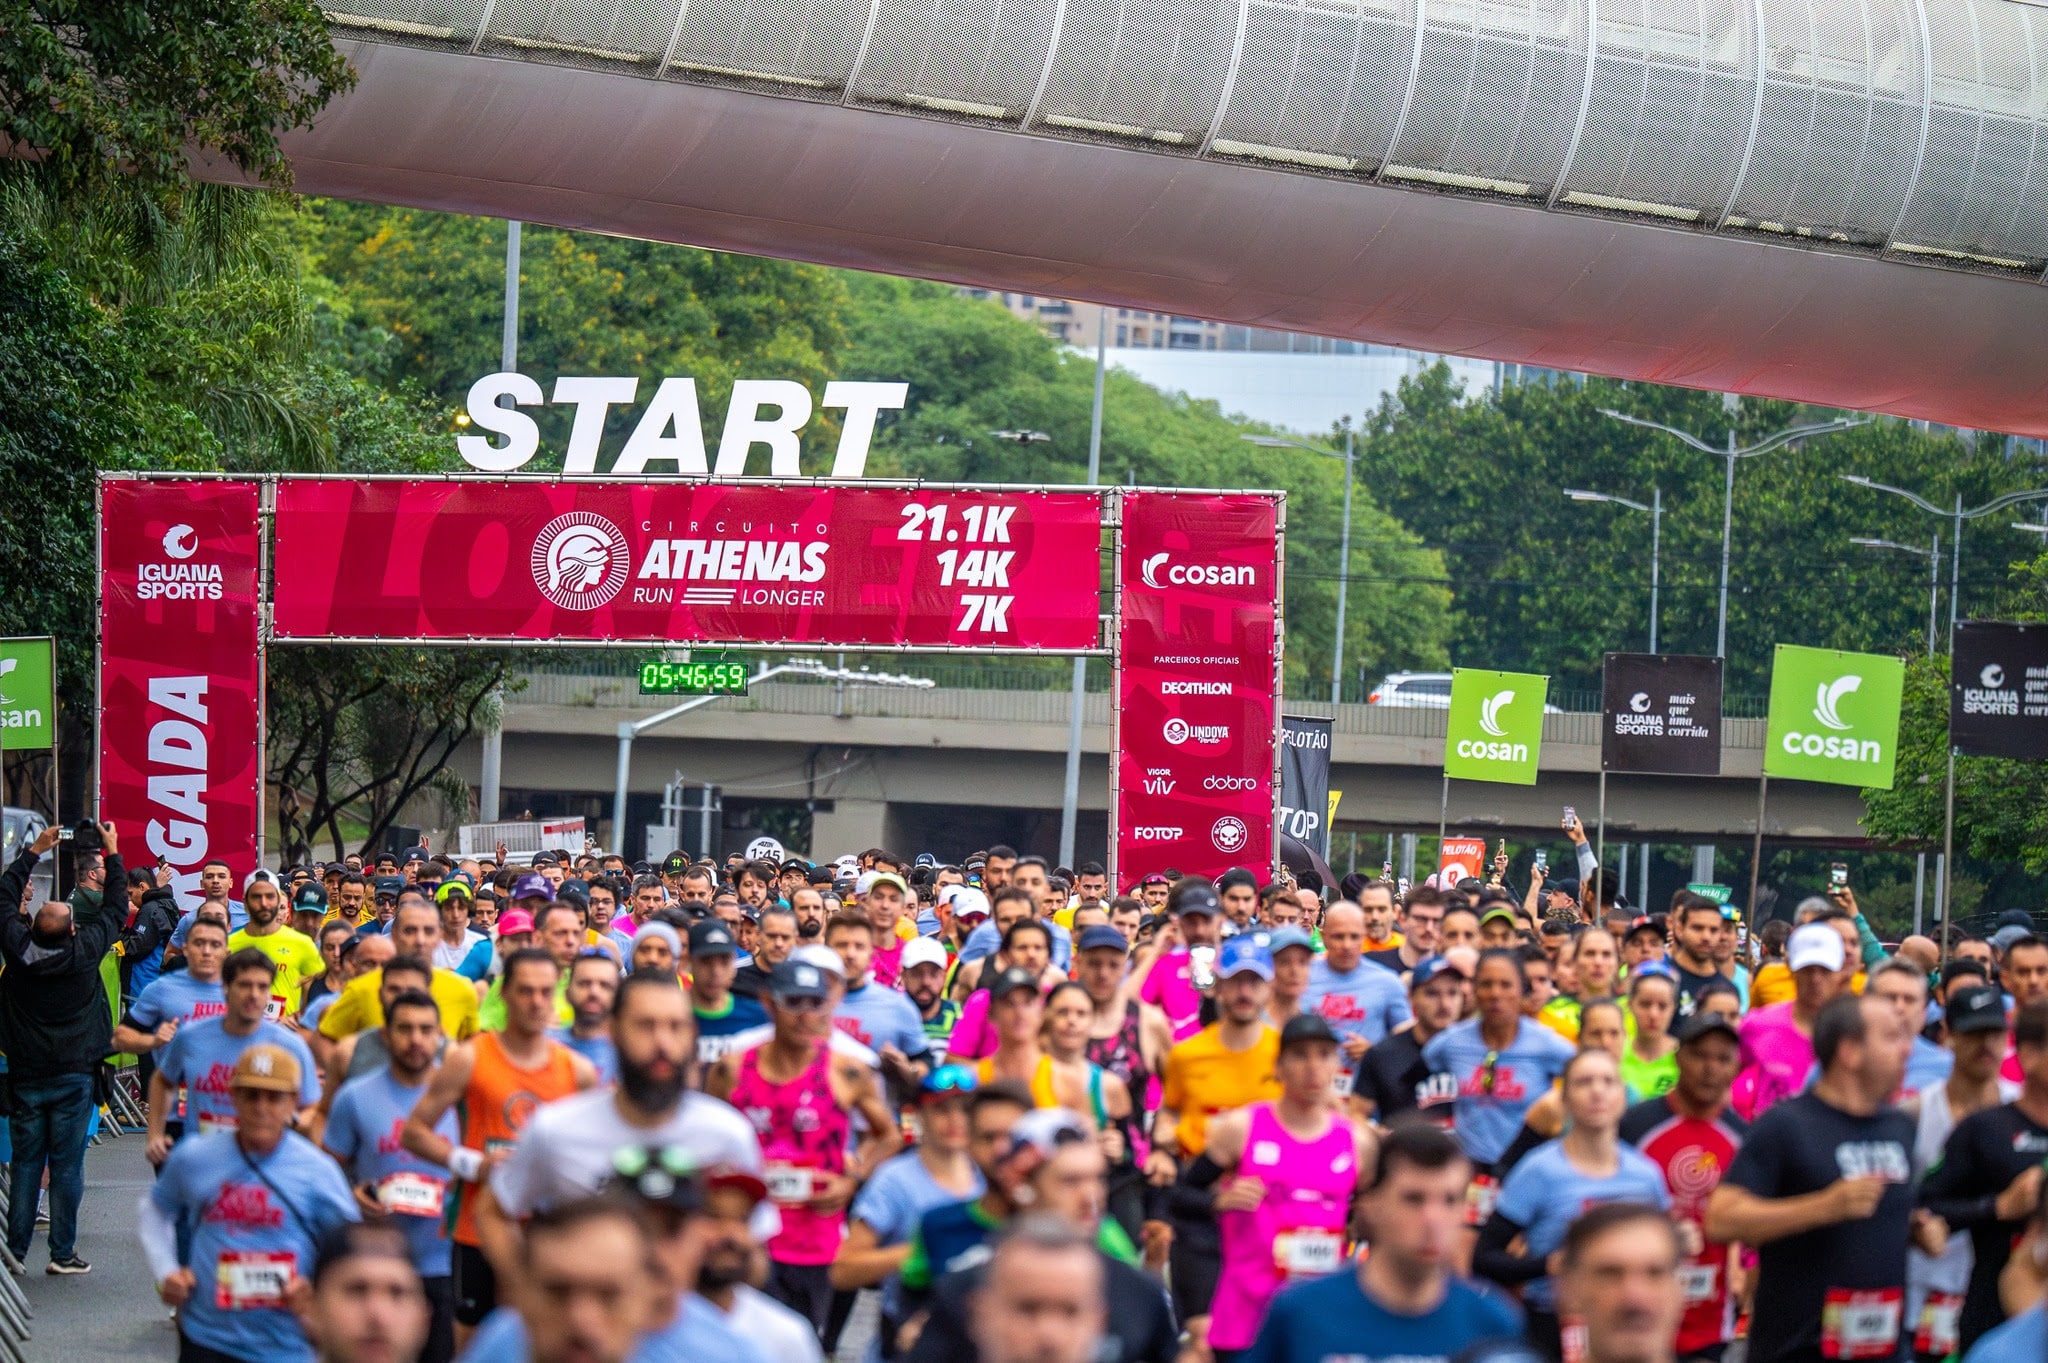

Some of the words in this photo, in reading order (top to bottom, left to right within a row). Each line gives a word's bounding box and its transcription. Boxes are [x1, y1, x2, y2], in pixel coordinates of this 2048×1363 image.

[457, 373, 909, 476] START
[641, 520, 828, 535] CIRCUITO
[897, 504, 1017, 543] 21.1K
[637, 539, 831, 583] ATHENAS
[936, 549, 1016, 588] 14K
[138, 563, 224, 582] IGUANA
[1168, 565, 1256, 585] cosan
[137, 580, 223, 601] SPORTS
[633, 587, 674, 604] RUN
[742, 589, 826, 607] LONGER
[956, 594, 1015, 633] 7K
[1153, 655, 1201, 665] PARCEIROS
[1202, 656, 1240, 665] OFICIAIS
[1161, 681, 1232, 695] DECATHLON
[1668, 693, 1696, 705] mais
[1964, 689, 2019, 704] IGUANA
[1668, 706, 1689, 718] que
[1963, 702, 2019, 716] SPORTS
[1615, 713, 1664, 726] IGUANA
[1668, 717, 1694, 726] uma
[1189, 726, 1230, 738] LINDOYA
[1615, 725, 1664, 736] SPORTS
[1667, 726, 1709, 738] corrida
[1281, 728, 1328, 750] PELOTÃO
[1456, 739, 1528, 763] cosan
[1782, 731, 1881, 764] cosan
[1147, 768, 1171, 776] VIGOR
[1203, 775, 1257, 790] dobro
[1134, 827, 1184, 840] FOTOP
[1213, 819, 1230, 835] BLACK
[1230, 819, 1245, 836] SKULL
